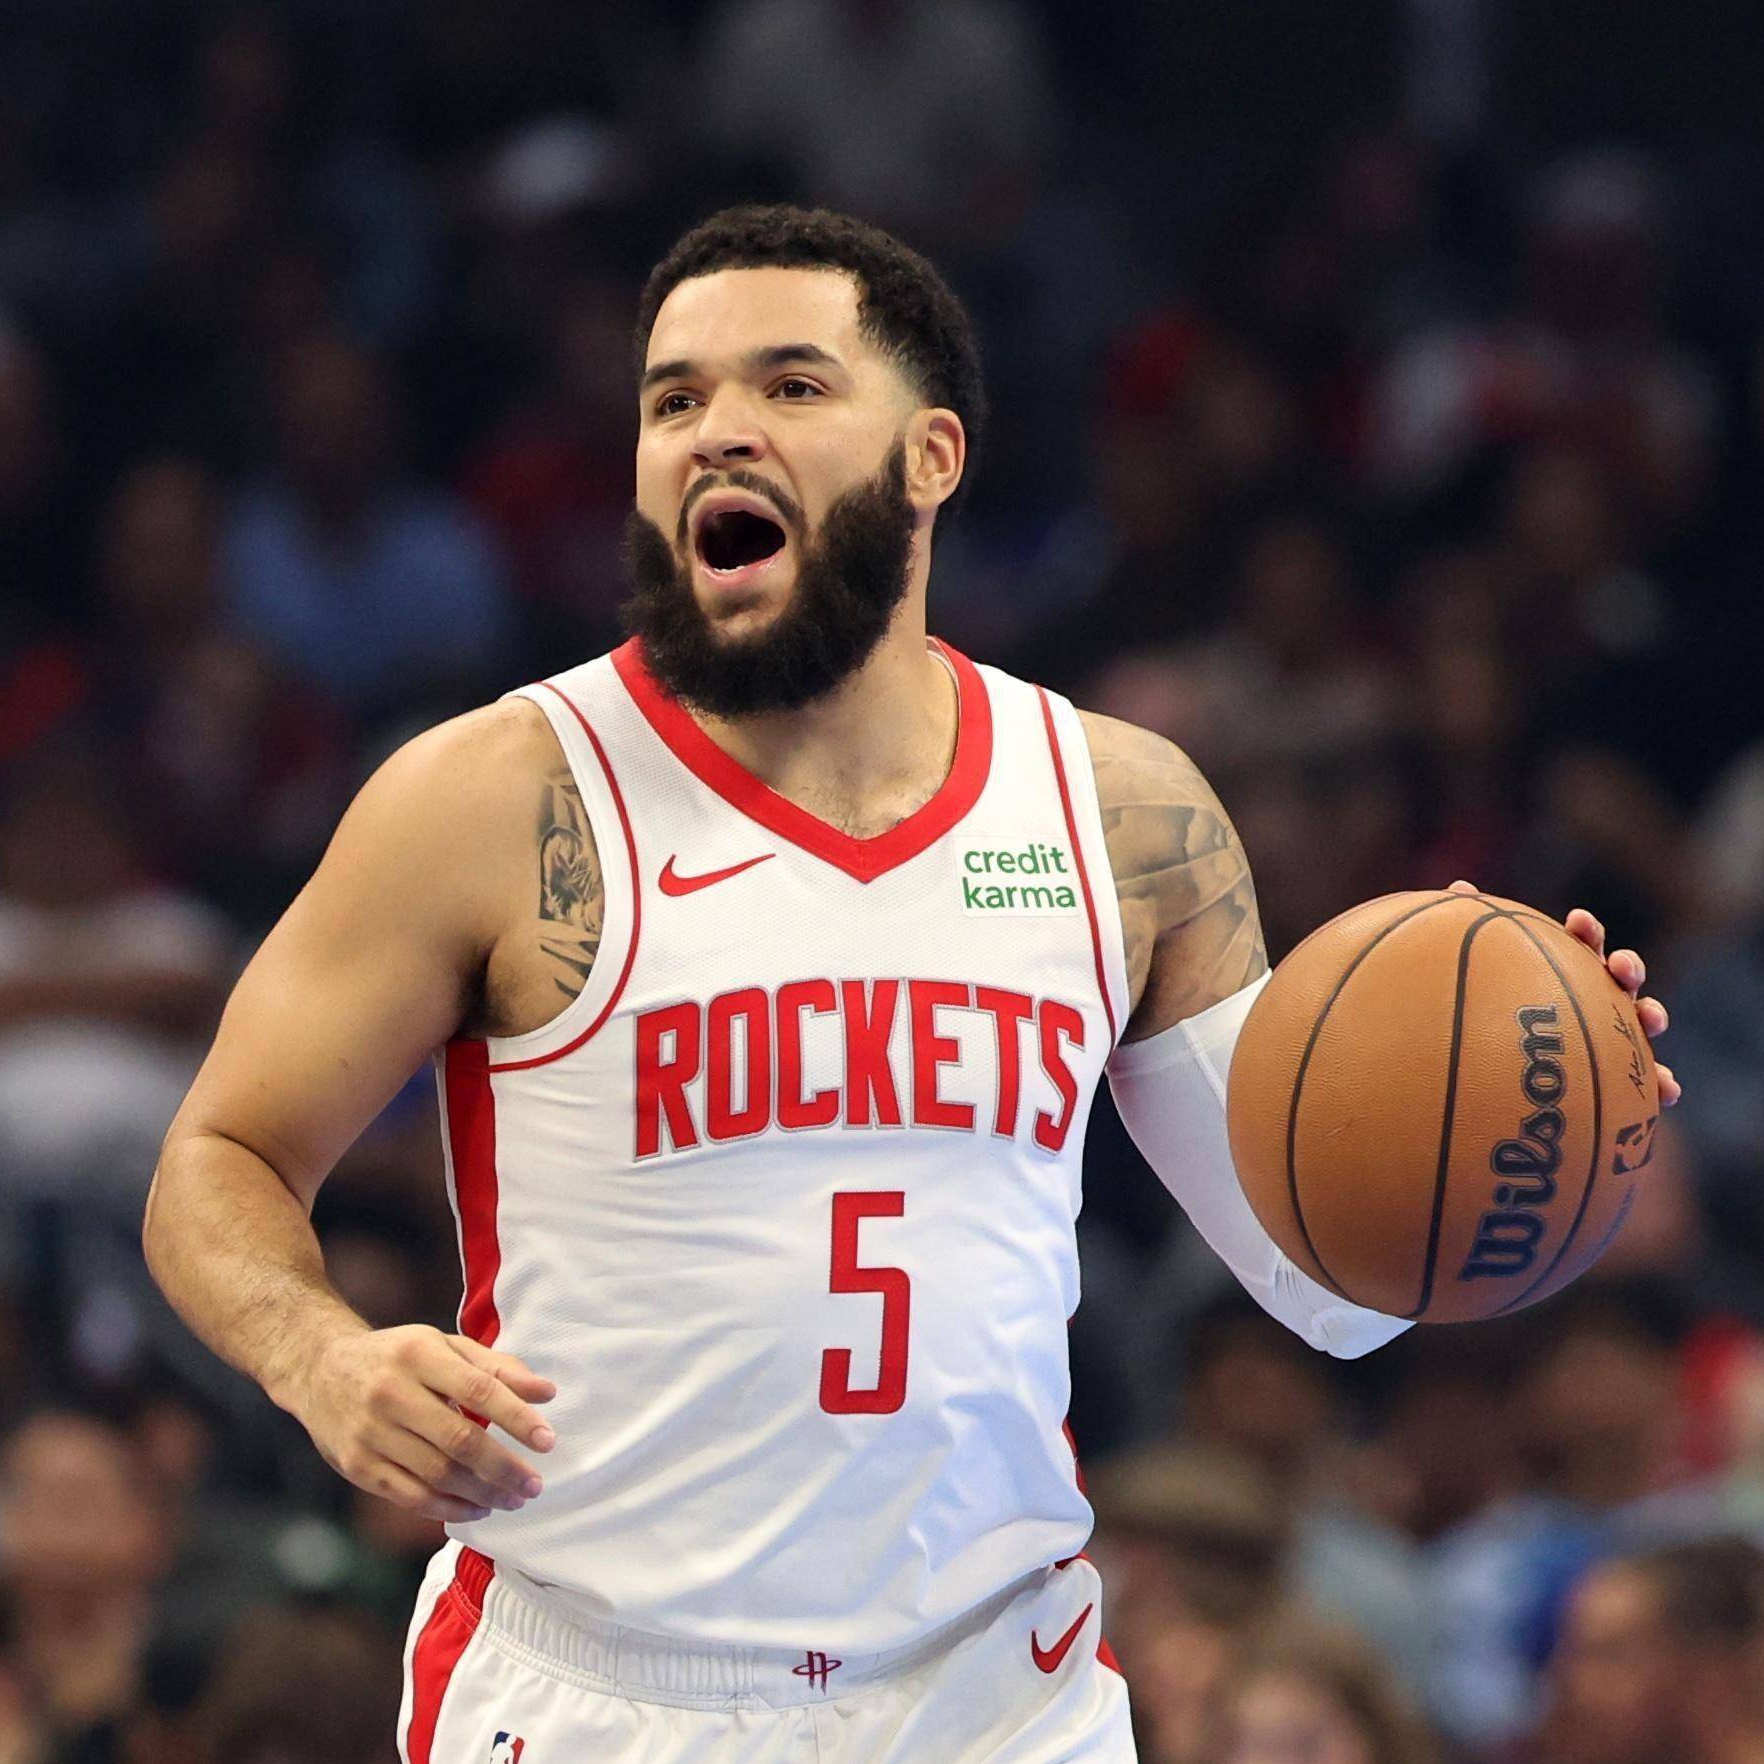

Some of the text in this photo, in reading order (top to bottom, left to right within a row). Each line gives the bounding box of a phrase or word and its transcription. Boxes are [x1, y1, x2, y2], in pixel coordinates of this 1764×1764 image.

[962, 876, 1077, 908] karma
[964, 843, 1068, 874] credit
[633, 975, 1087, 1160] ROCKETS
[1457, 1003, 1567, 1281] Wilson
[819, 1190, 912, 1415] 5
